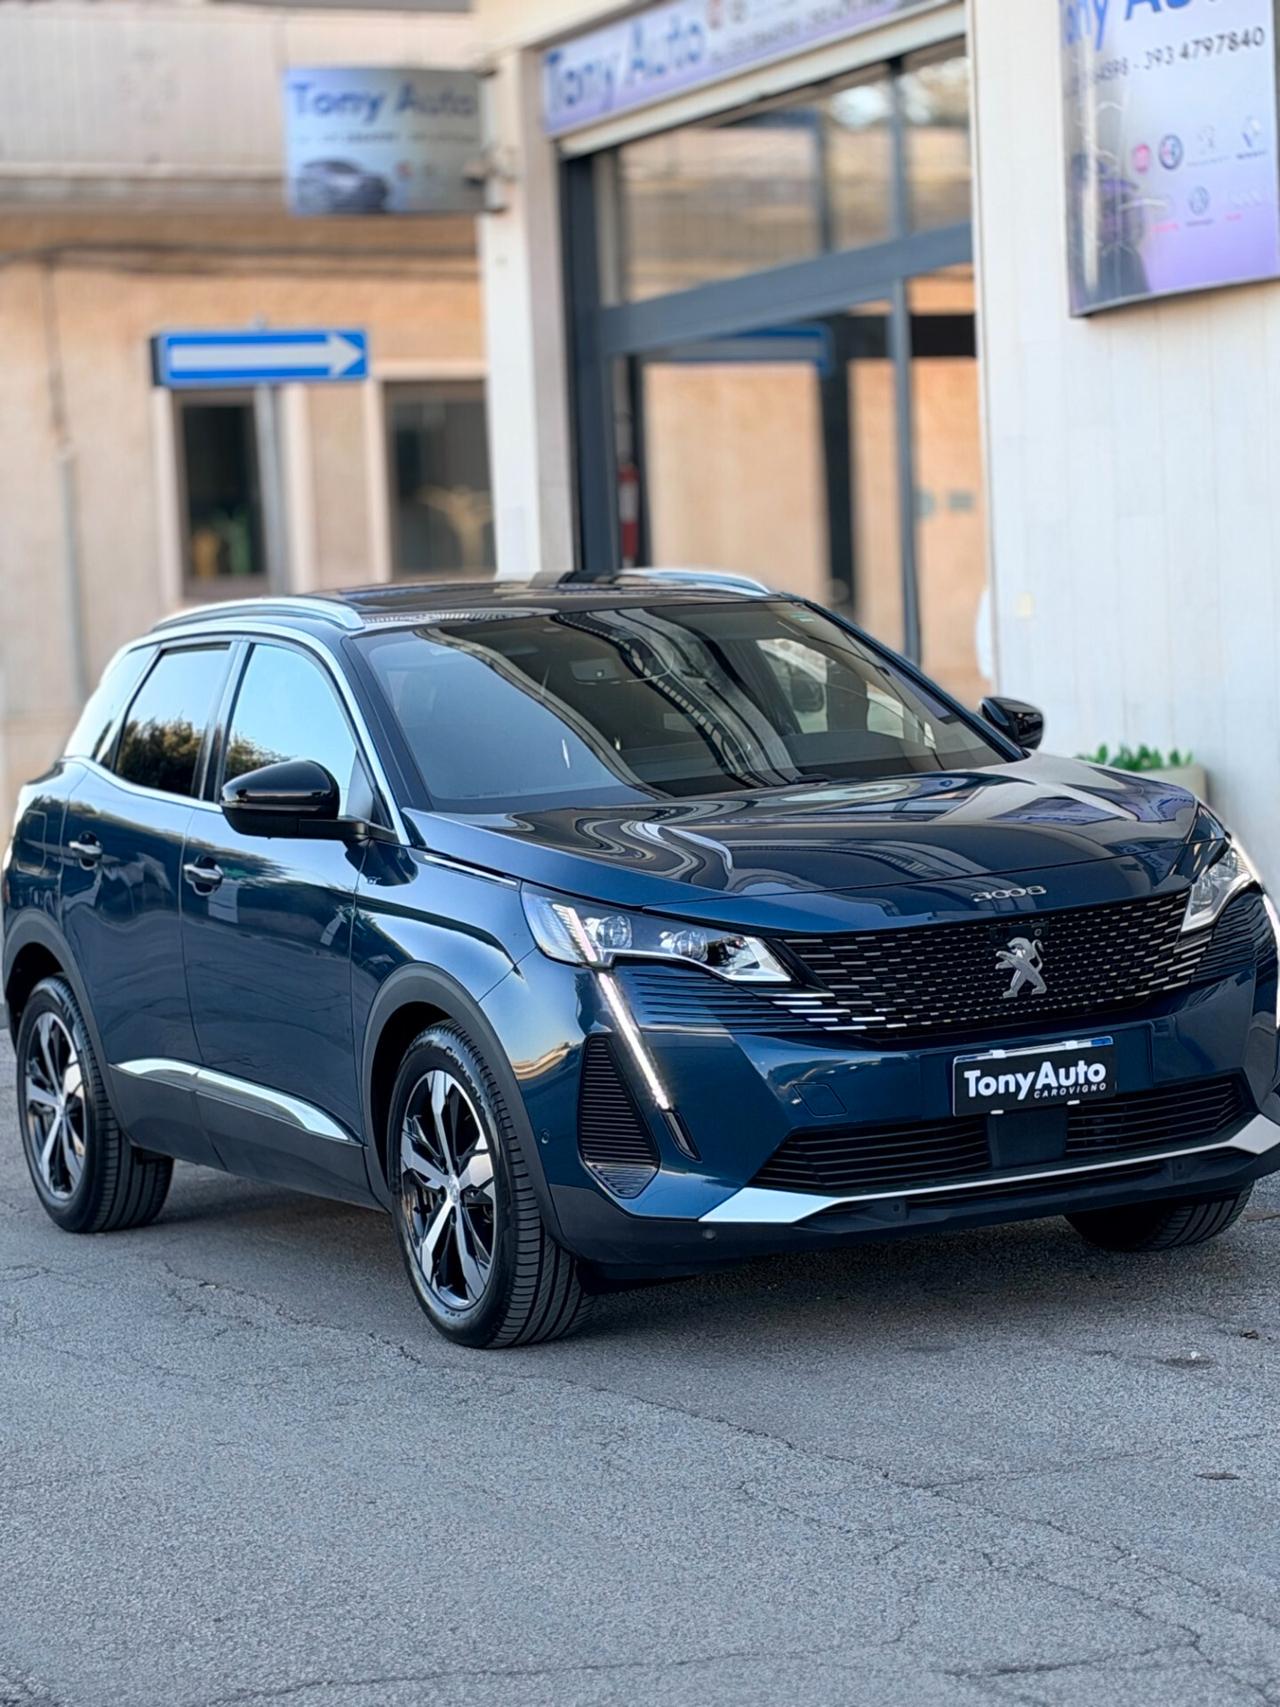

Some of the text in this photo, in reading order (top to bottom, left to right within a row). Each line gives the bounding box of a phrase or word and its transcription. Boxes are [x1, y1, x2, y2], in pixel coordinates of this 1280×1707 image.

[1179, 26, 1265, 60] 4797840
[290, 82, 477, 121] Tony Auto
[1034, 1082, 1107, 1099] CAROVIGNO
